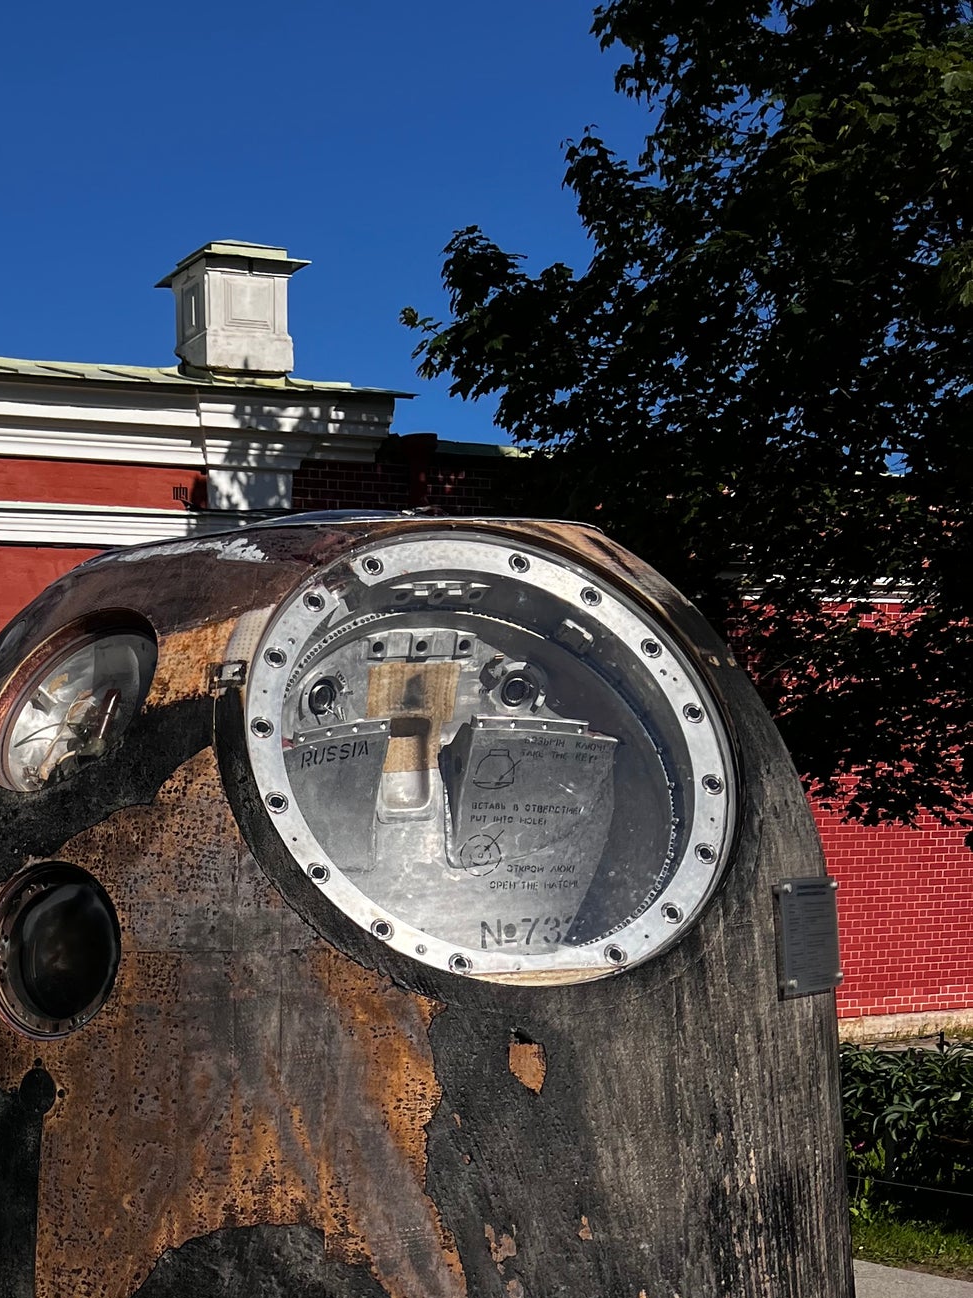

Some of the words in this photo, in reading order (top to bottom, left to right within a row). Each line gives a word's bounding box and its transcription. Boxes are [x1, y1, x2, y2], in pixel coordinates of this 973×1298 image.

[300, 740, 369, 769] RUSSIA
[470, 814, 488, 823] PUT
[506, 864, 545, 874] ОТКРОЙ
[489, 880, 517, 890] OPEN
[521, 881, 539, 890] THE
